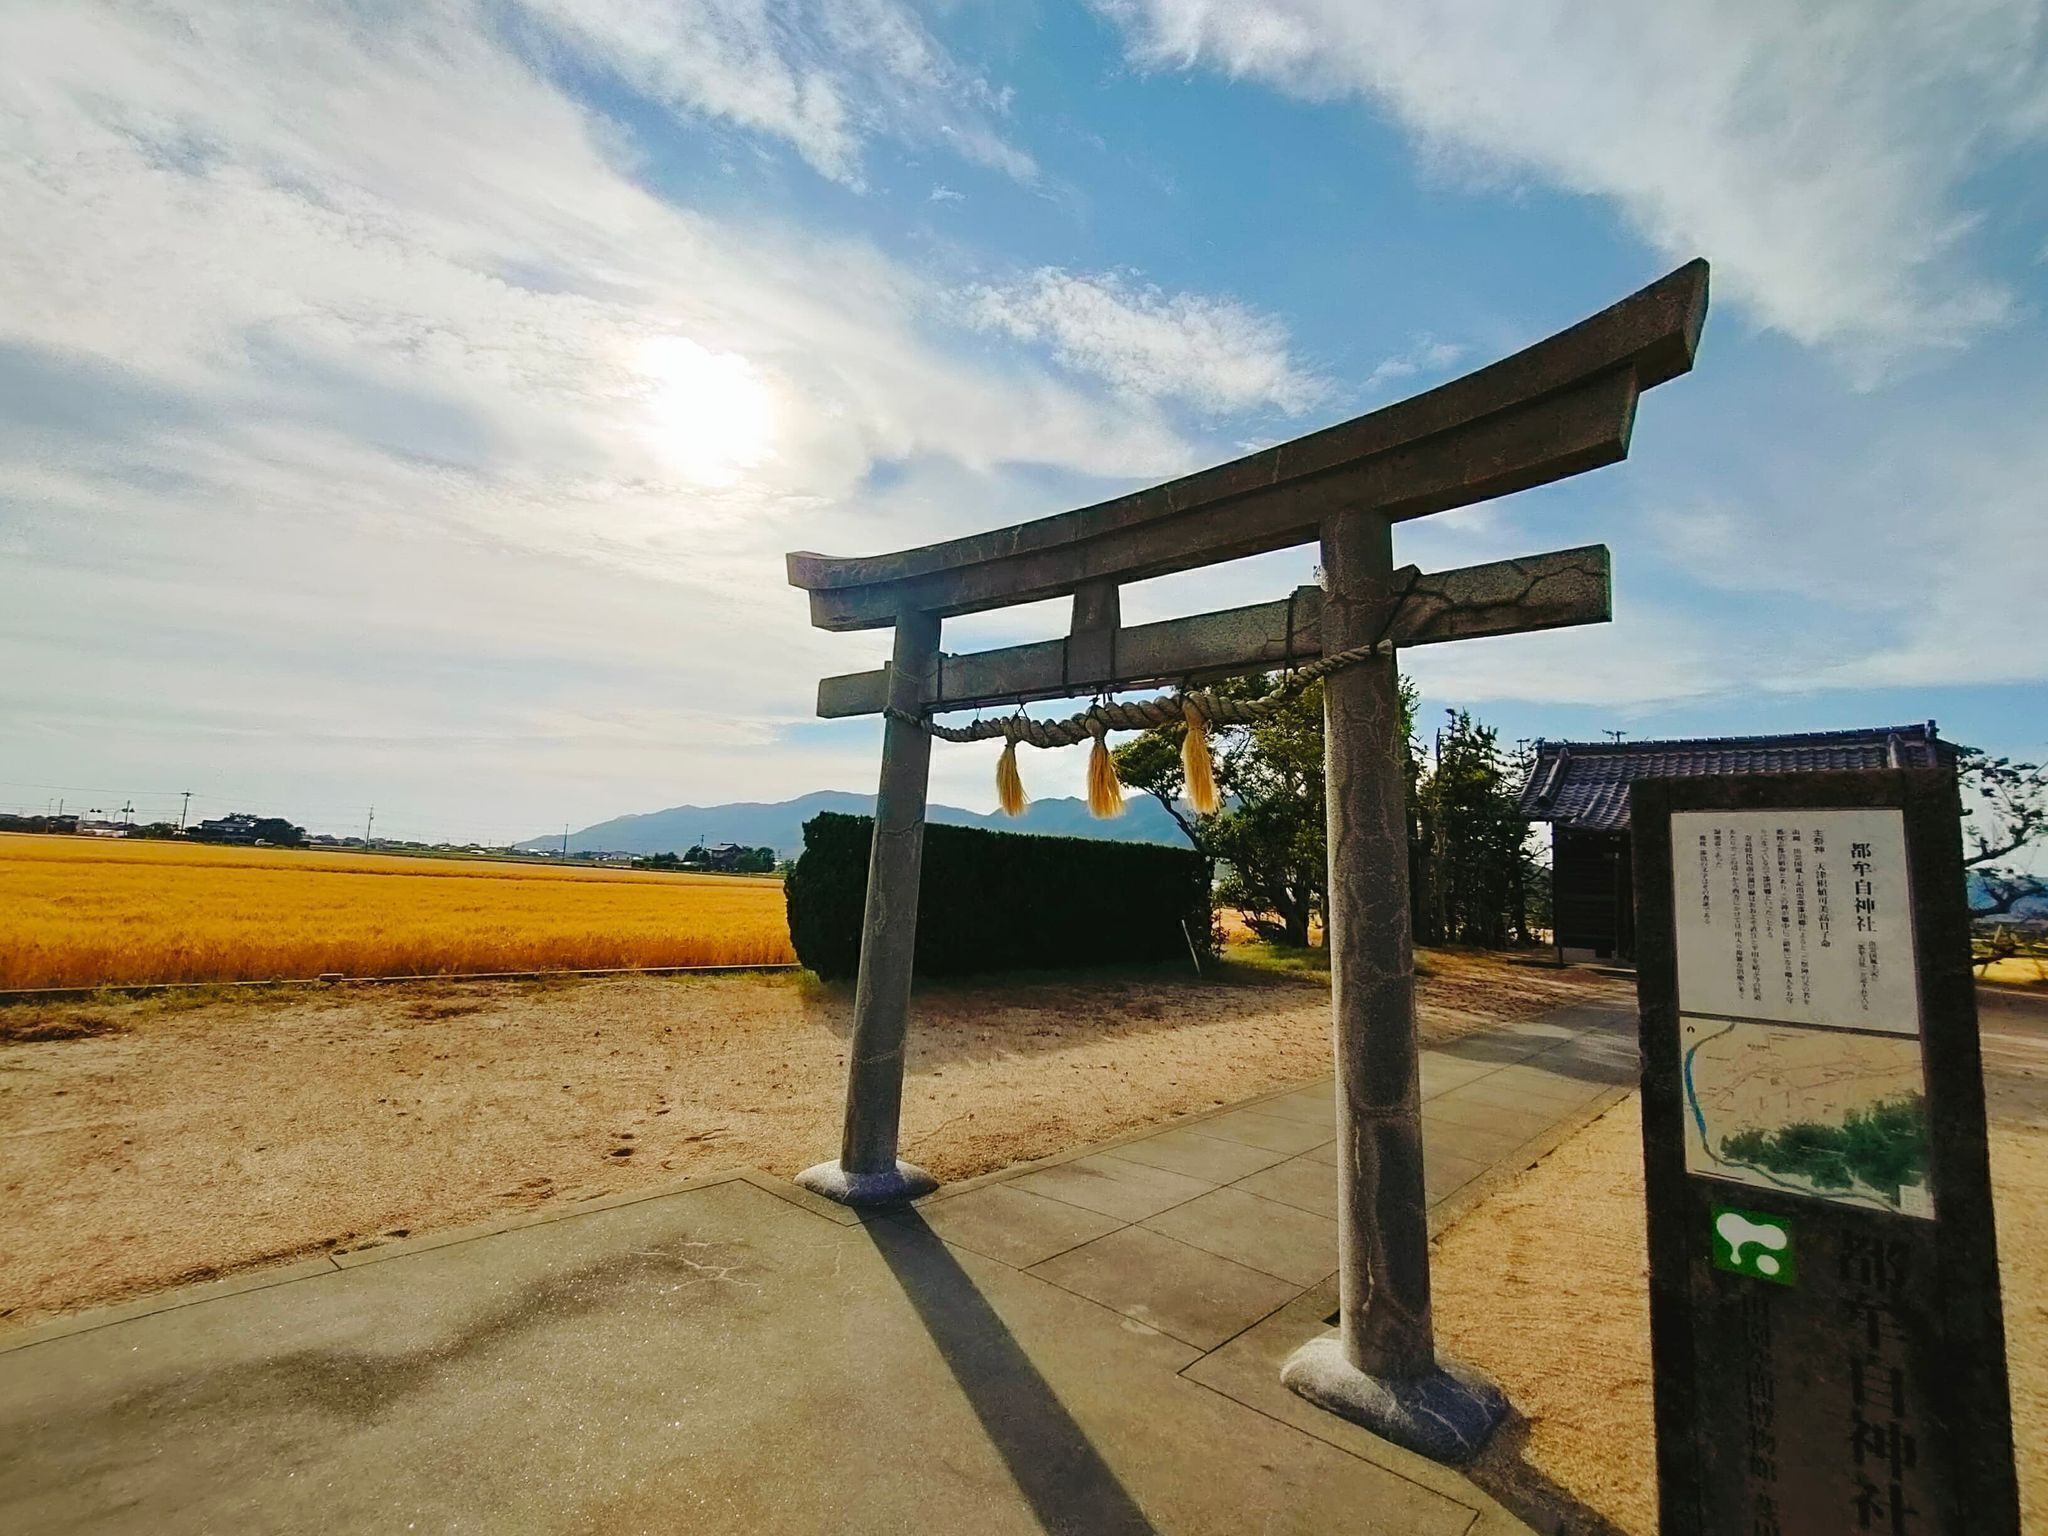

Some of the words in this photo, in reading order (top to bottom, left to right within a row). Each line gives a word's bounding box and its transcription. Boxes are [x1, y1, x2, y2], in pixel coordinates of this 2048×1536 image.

[1850, 842, 1878, 933] 都牟自神社
